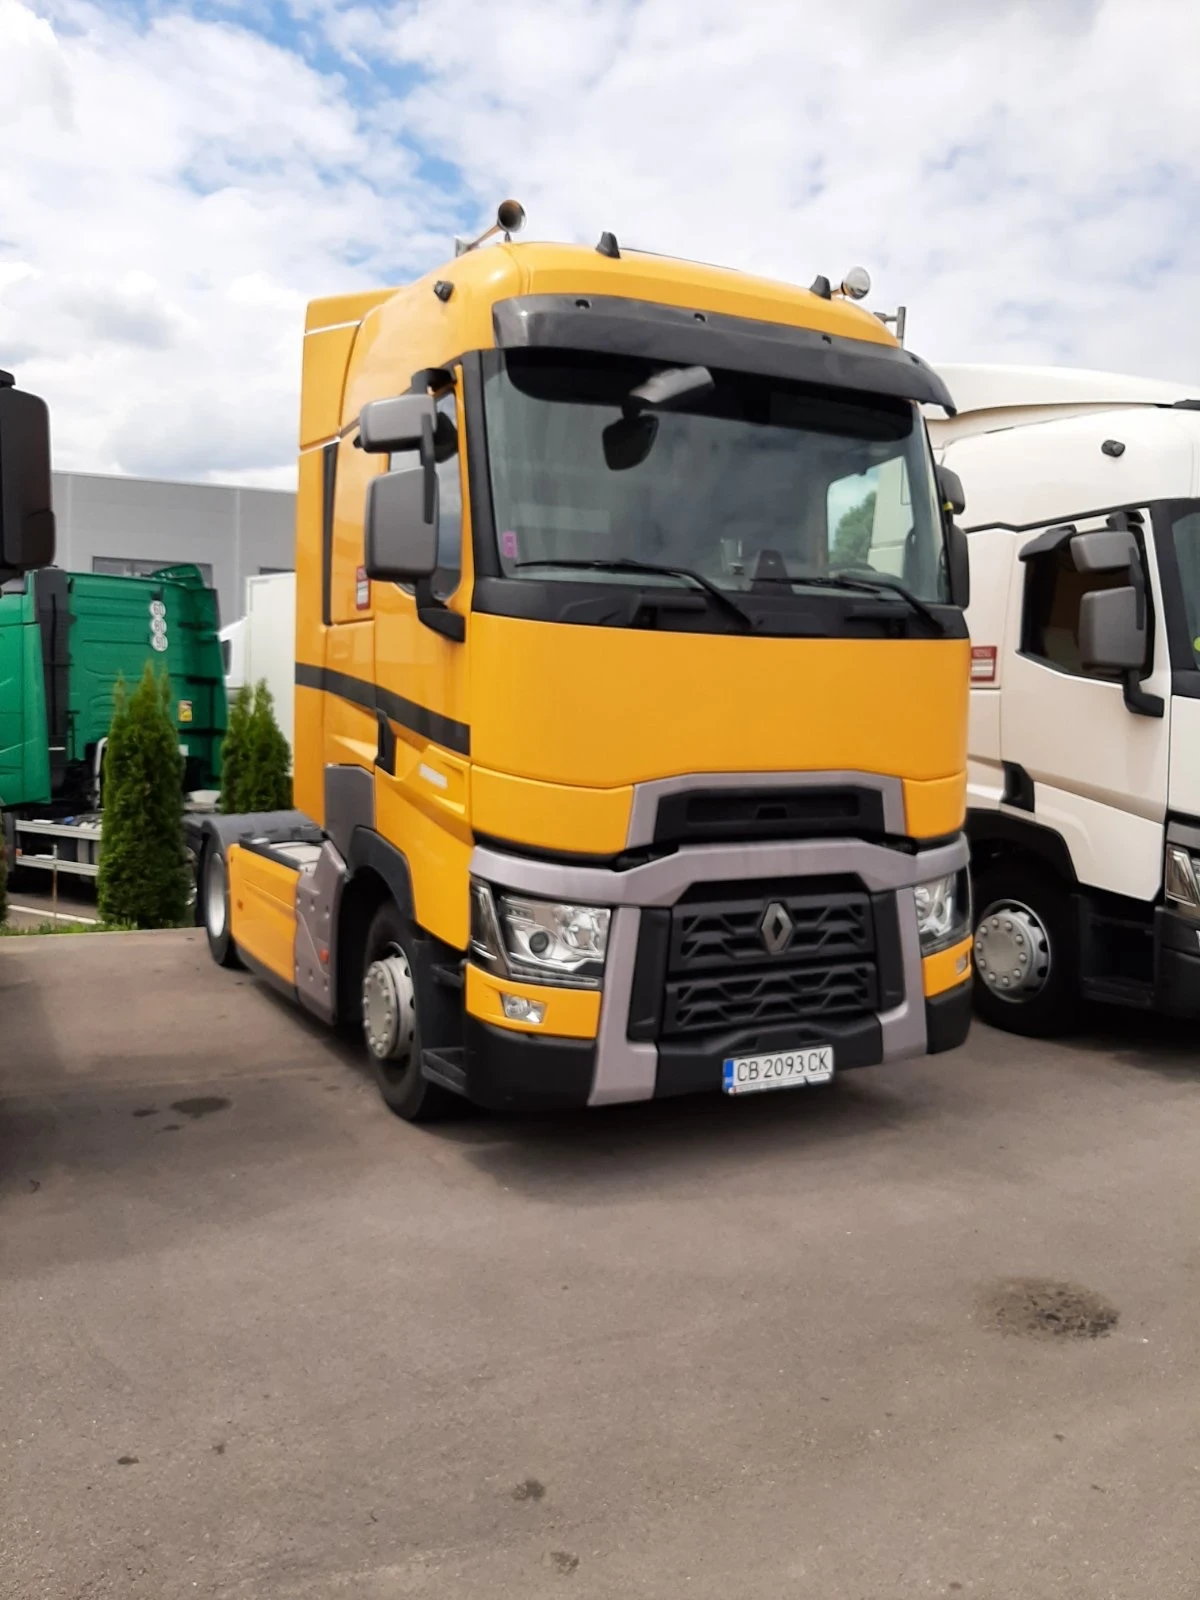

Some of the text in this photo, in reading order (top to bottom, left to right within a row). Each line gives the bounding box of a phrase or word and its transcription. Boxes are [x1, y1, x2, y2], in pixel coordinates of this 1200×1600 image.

[737, 1050, 829, 1082] CB 2093 CK
